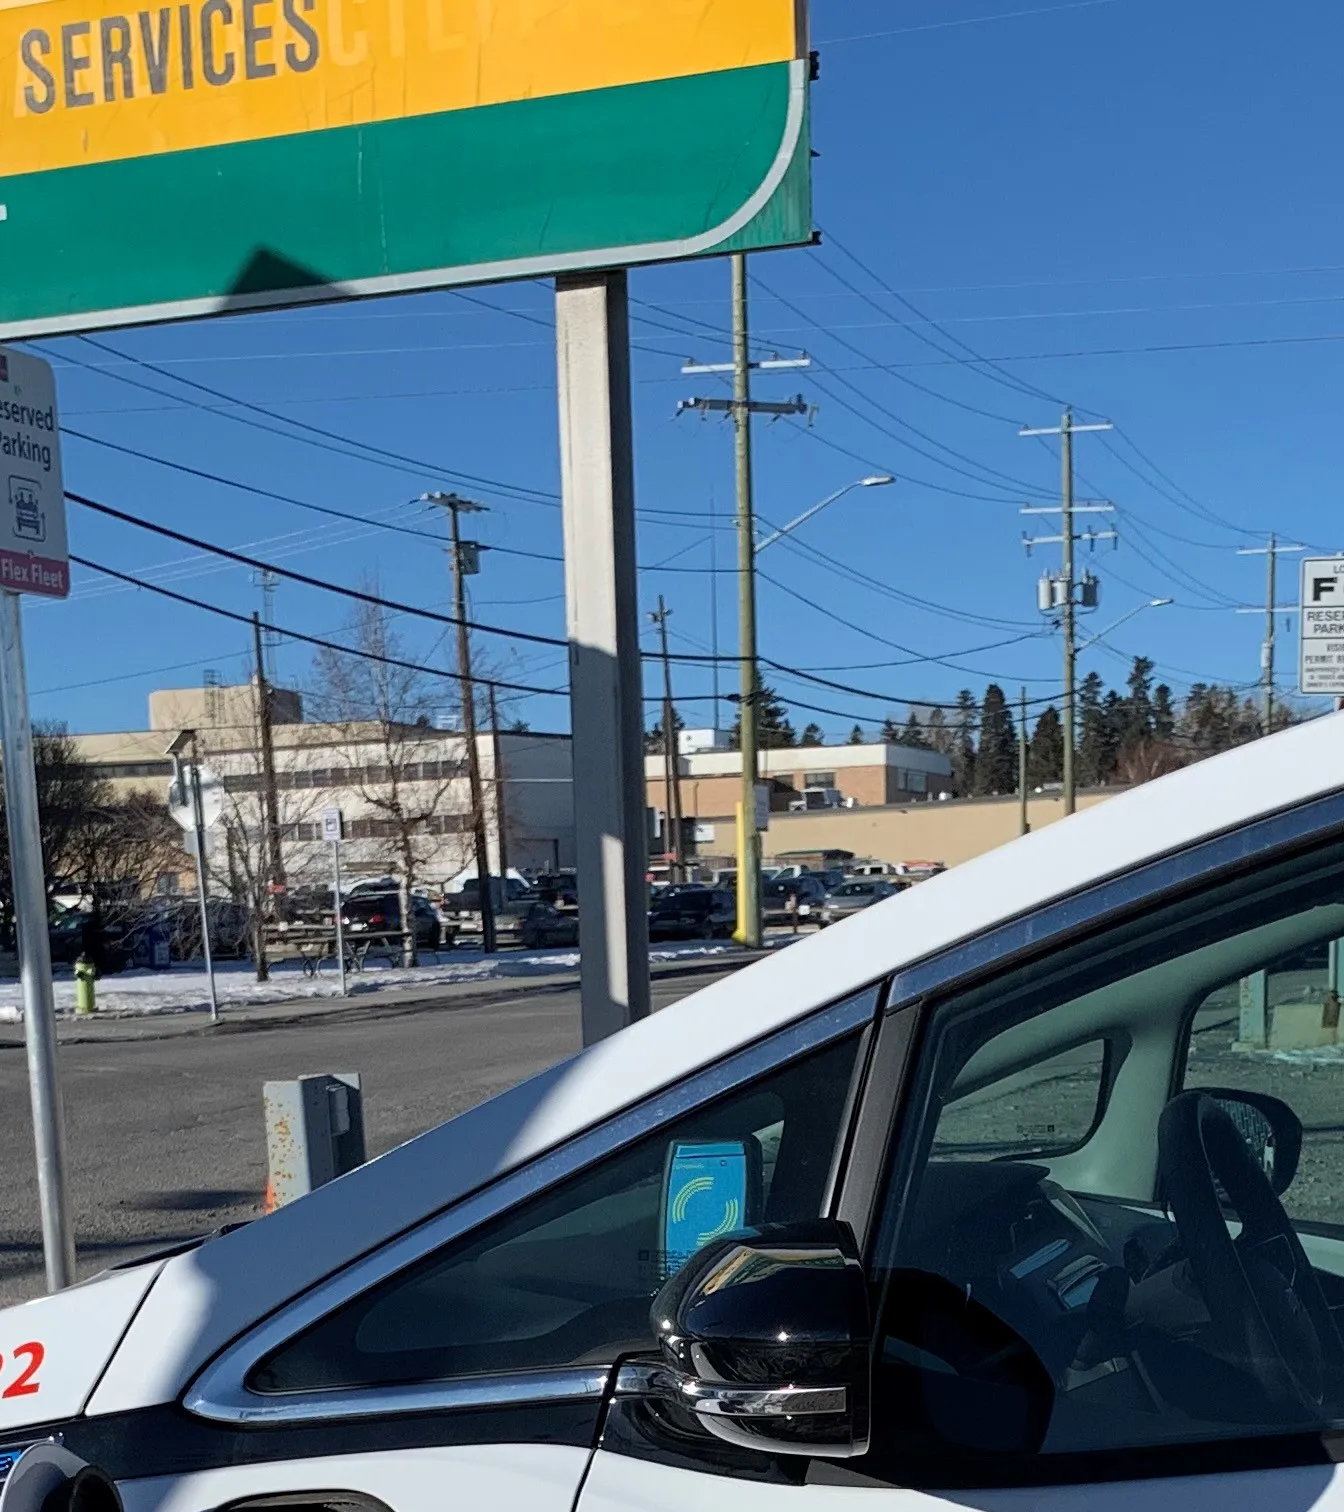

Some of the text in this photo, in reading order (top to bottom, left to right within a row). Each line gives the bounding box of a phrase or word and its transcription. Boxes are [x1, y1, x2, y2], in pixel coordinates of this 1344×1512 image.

[20, 0, 320, 114] SERVICES
[0, 558, 64, 589] Flex Fleet
